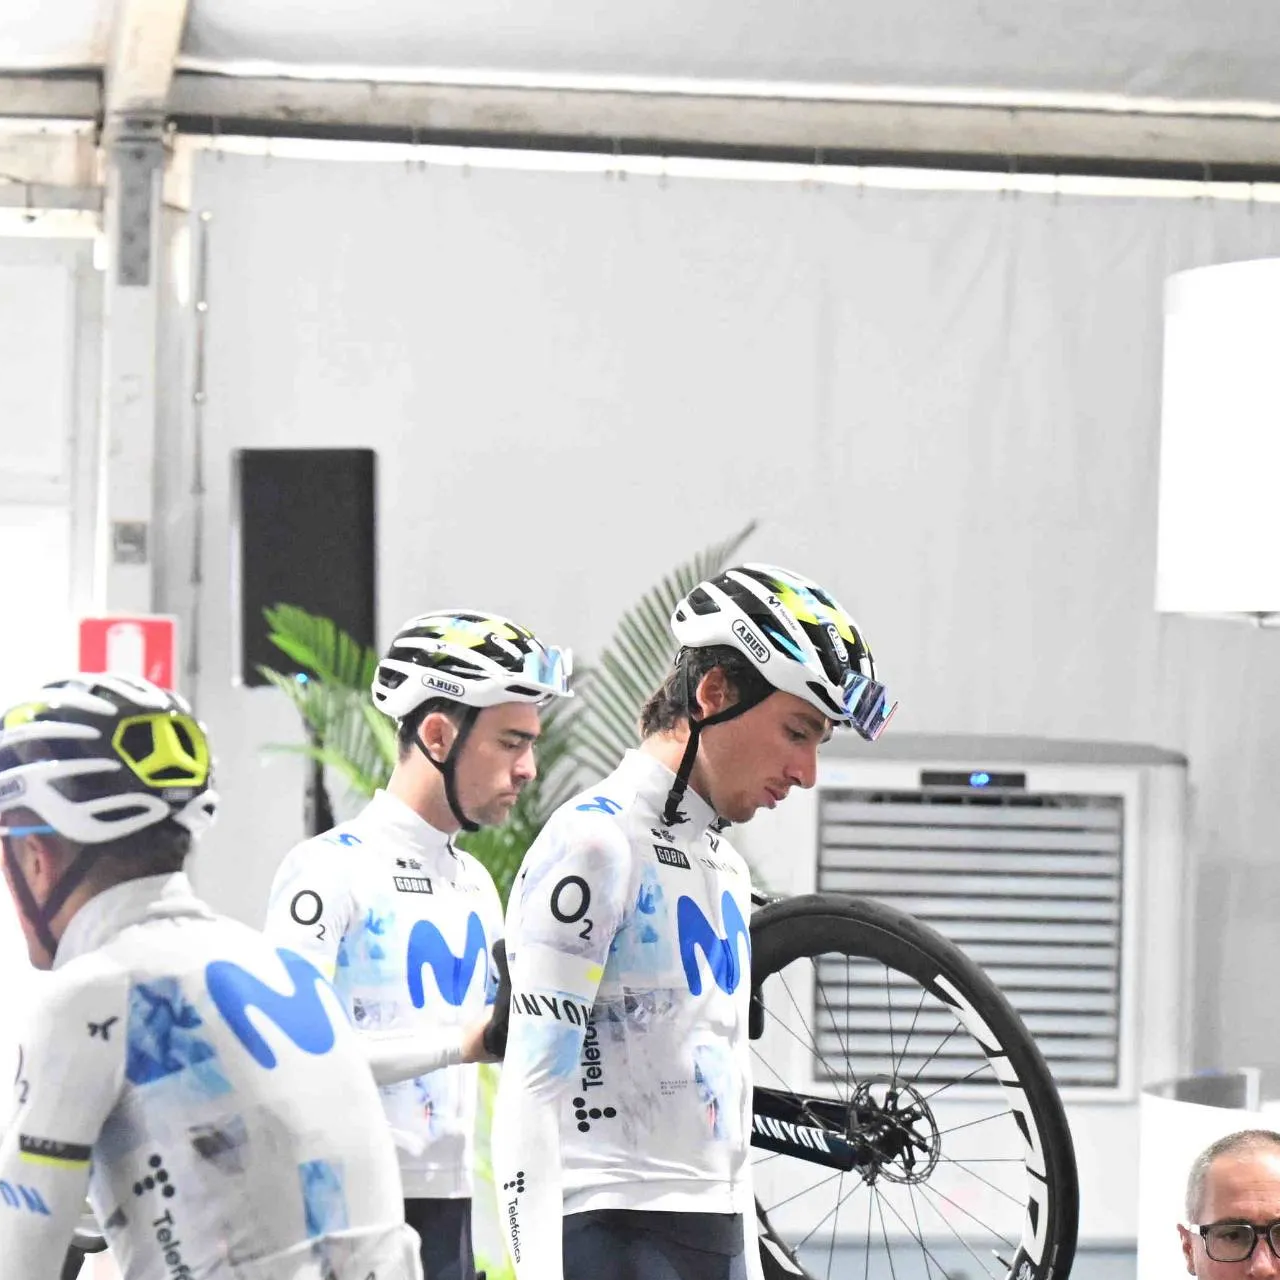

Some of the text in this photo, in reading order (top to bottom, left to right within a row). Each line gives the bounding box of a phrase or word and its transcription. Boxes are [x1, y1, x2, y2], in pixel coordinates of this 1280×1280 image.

[737, 625, 766, 658] ABUS
[427, 677, 461, 694] ABUS
[508, 1198, 521, 1265] Telefónica
